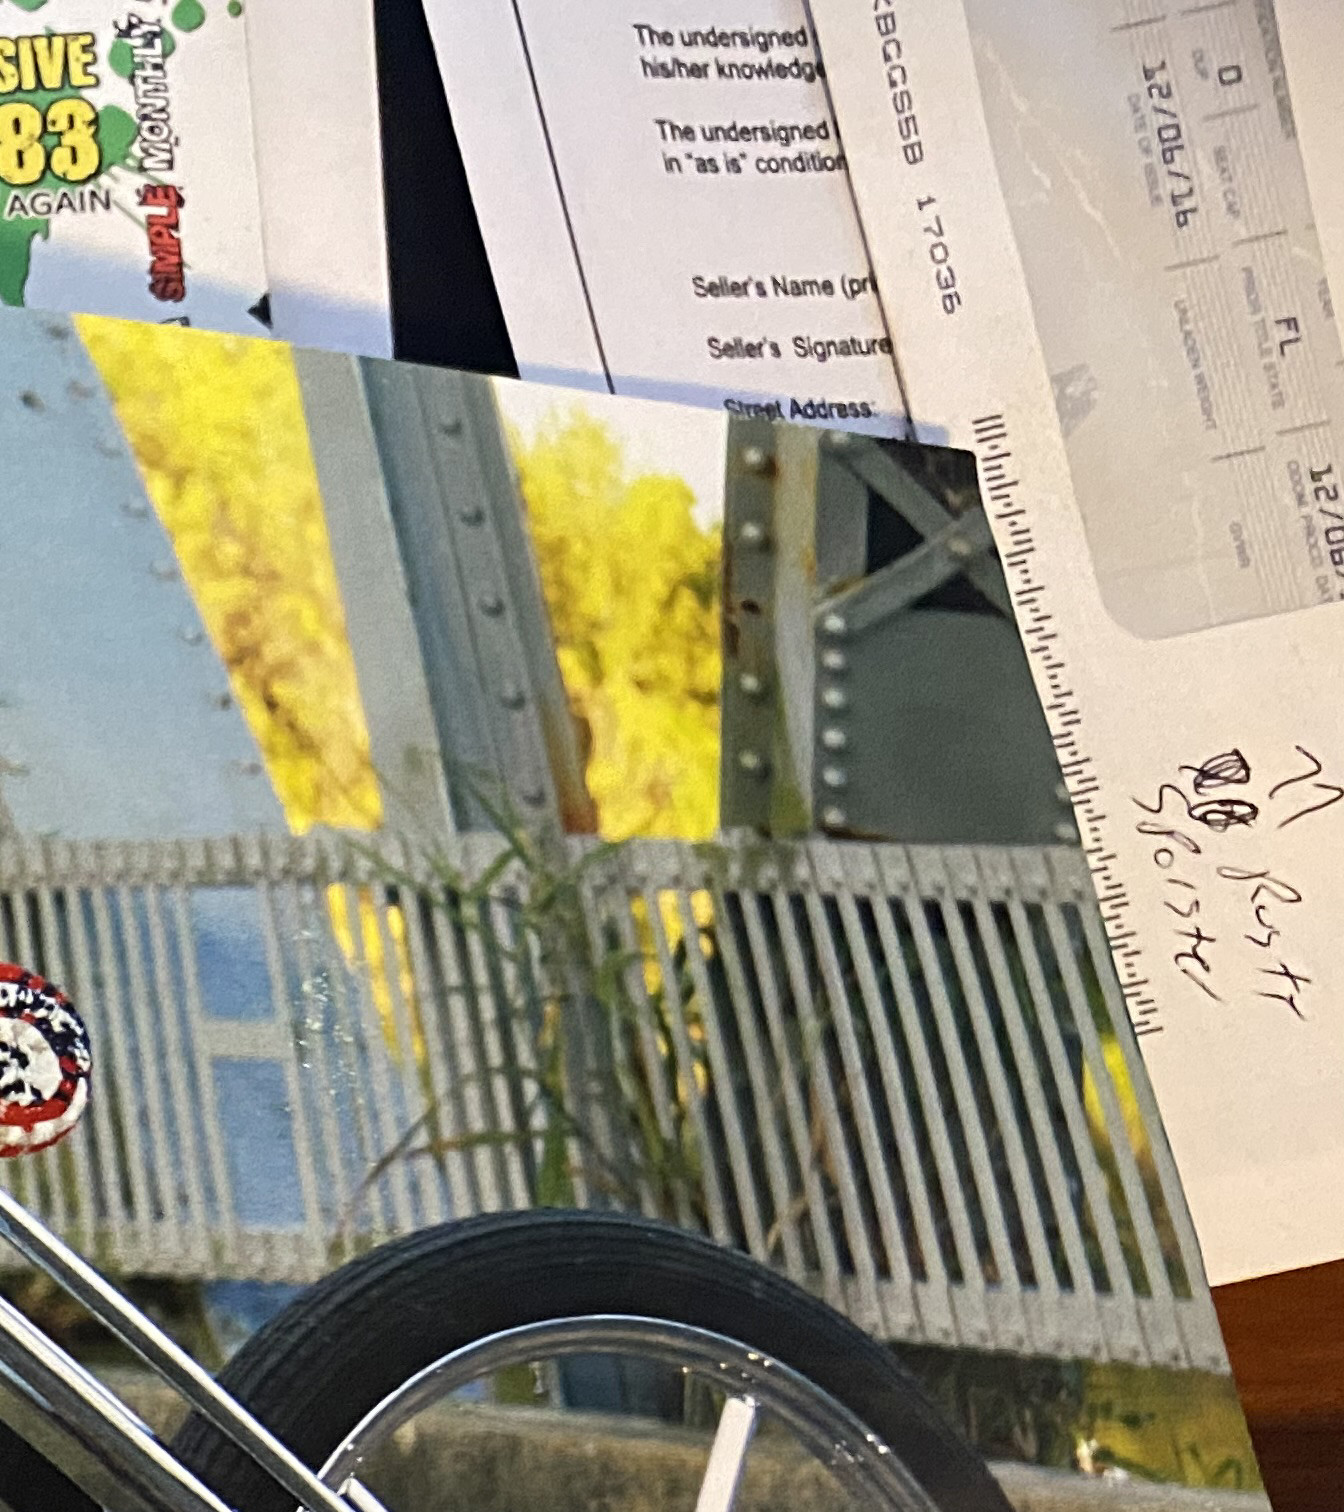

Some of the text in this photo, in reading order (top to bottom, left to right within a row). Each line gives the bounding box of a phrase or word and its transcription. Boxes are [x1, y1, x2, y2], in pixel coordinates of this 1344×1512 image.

[633, 24, 808, 52] The undersigned
[640, 57, 709, 78] his/her
[654, 119, 830, 147] The undersigned
[1143, 60, 1197, 229] 12/06/16
[663, 152, 682, 173] in
[7, 190, 112, 217] AGAIN
[916, 195, 962, 315] 17036
[692, 274, 767, 298] Seller's
[772, 274, 834, 297] Name
[707, 336, 893, 362] Seller's Signature
[1275, 316, 1301, 357] FL
